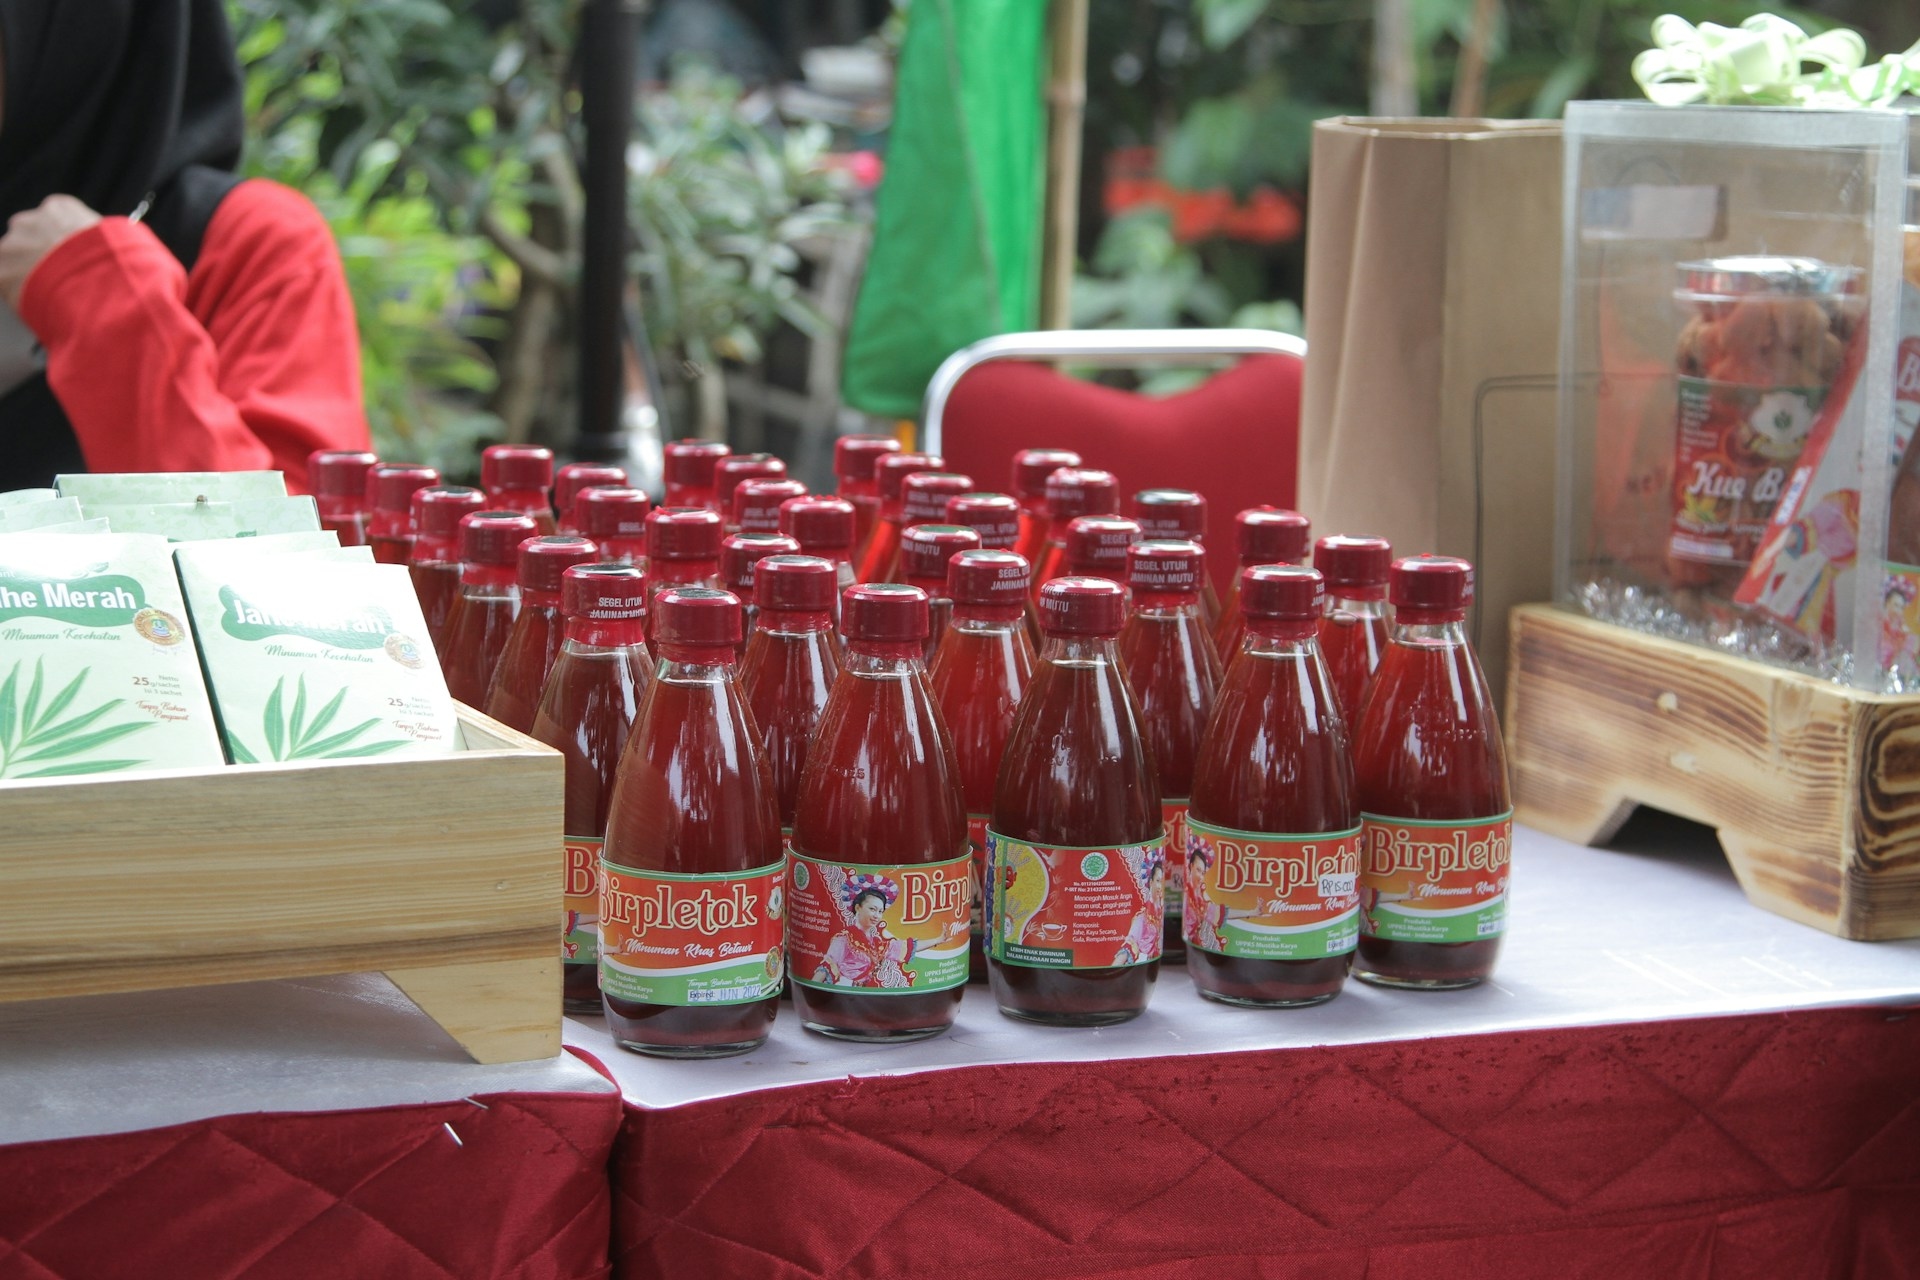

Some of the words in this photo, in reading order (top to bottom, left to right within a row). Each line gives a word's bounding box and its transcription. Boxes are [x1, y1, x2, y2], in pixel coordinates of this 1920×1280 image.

[1686, 460, 1746, 500] Kue
[914, 541, 941, 556] MUTU
[1134, 560, 1160, 571] SEGEL
[1162, 560, 1188, 571] UTUH
[998, 567, 1021, 579] SEGEL
[1167, 572, 1194, 584] MUTU
[41, 583, 137, 610] Merah
[598, 597, 623, 608] SEGEL
[2, 628, 59, 641] Minuman
[63, 628, 121, 642] Kesehatan
[264, 644, 317, 659] Minuman
[321, 648, 375, 664] Kesehatan
[132, 676, 149, 686] 25
[387, 697, 404, 706] 25
[1102, 893, 1119, 901] Masuk
[1418, 883, 1472, 898] Minuman
[600, 871, 758, 938] Birpletok
[1266, 899, 1322, 914] Minuman
[1325, 896, 1346, 912] Khas
[1086, 929, 1098, 937] Kayu
[625, 938, 680, 956] Minuman
[684, 943, 715, 959] Khas
[718, 940, 754, 958] Betawi
[1010, 946, 1024, 954] LEBIH
[1006, 952, 1024, 960] DALAM
[1024, 955, 1050, 963] KEADAAN
[718, 988, 738, 1001] JUN
[742, 984, 761, 998] 2022
